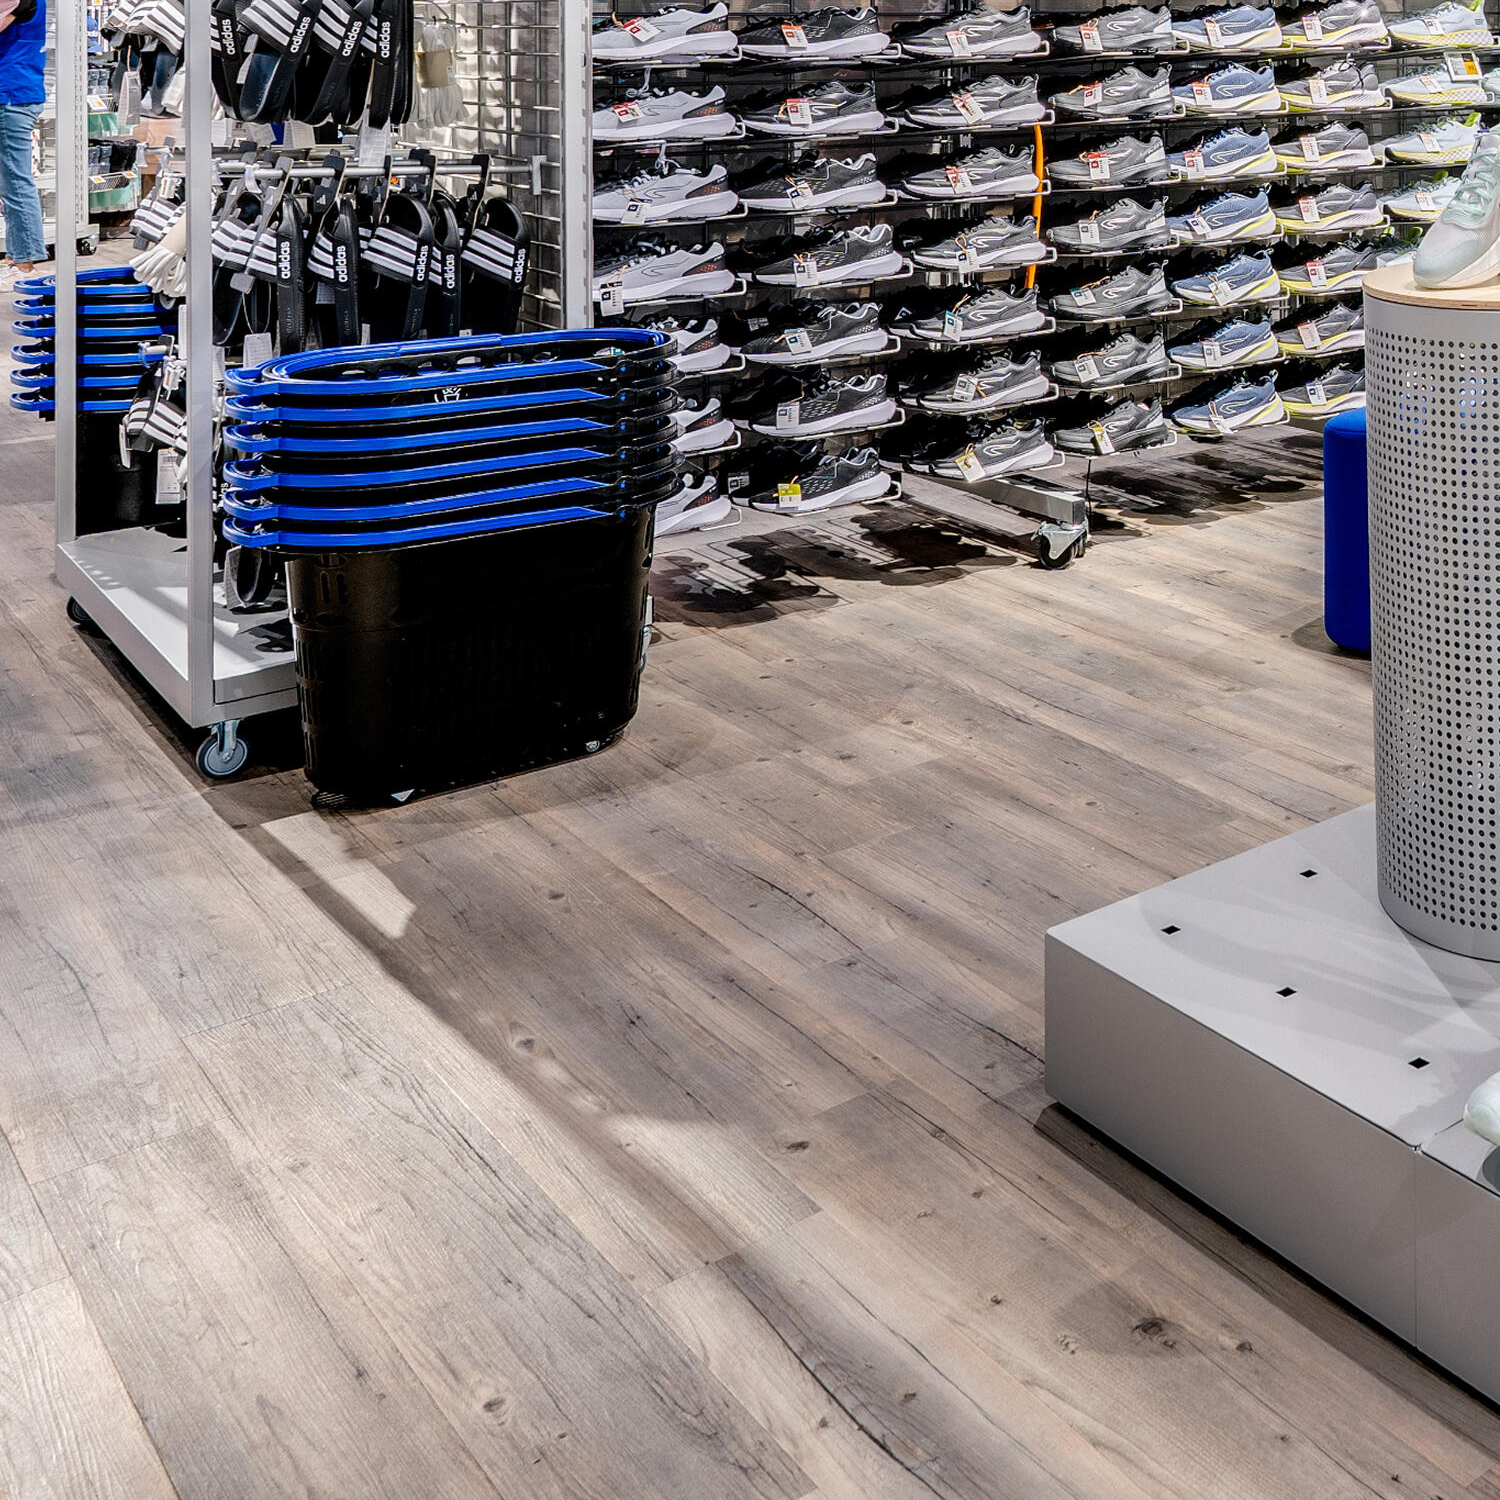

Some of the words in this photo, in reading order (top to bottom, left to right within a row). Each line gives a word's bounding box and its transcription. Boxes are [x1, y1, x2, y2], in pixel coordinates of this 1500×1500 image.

[221, 18, 234, 56] adidas
[290, 15, 311, 54] adidas
[341, 19, 363, 57] adidas
[380, 20, 392, 59] adidas
[280, 240, 291, 280] adidas
[336, 244, 348, 284] adidas
[416, 244, 429, 283] adidas
[445, 253, 456, 290] adidas
[513, 248, 526, 284] adidas
